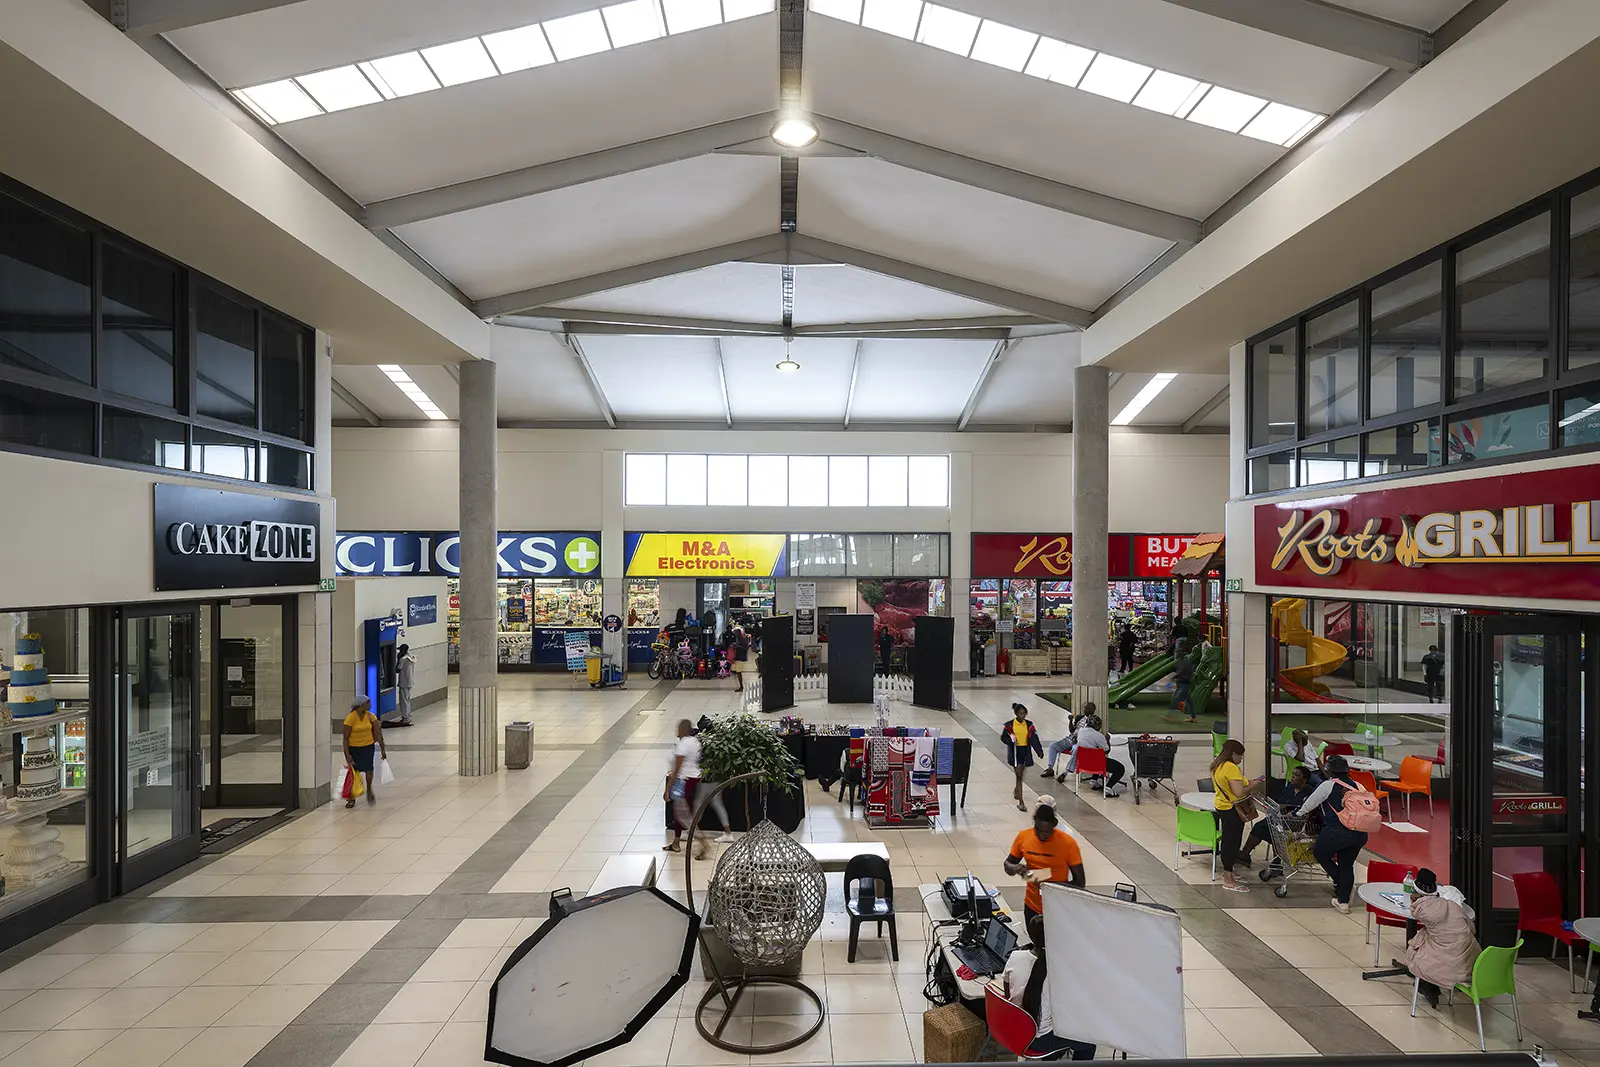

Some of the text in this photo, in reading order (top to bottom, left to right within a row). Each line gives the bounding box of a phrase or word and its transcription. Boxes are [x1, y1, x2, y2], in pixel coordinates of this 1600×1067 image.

[176, 521, 312, 559] CAKE ZONE
[1147, 537, 1196, 554] BUT
[1271, 500, 1600, 576] Roots GRILL
[682, 540, 731, 557] M&A
[1013, 536, 1073, 575] Ro
[657, 557, 756, 570] Electronics
[1147, 556, 1181, 567] MEA
[1531, 801, 1559, 810] GRILL
